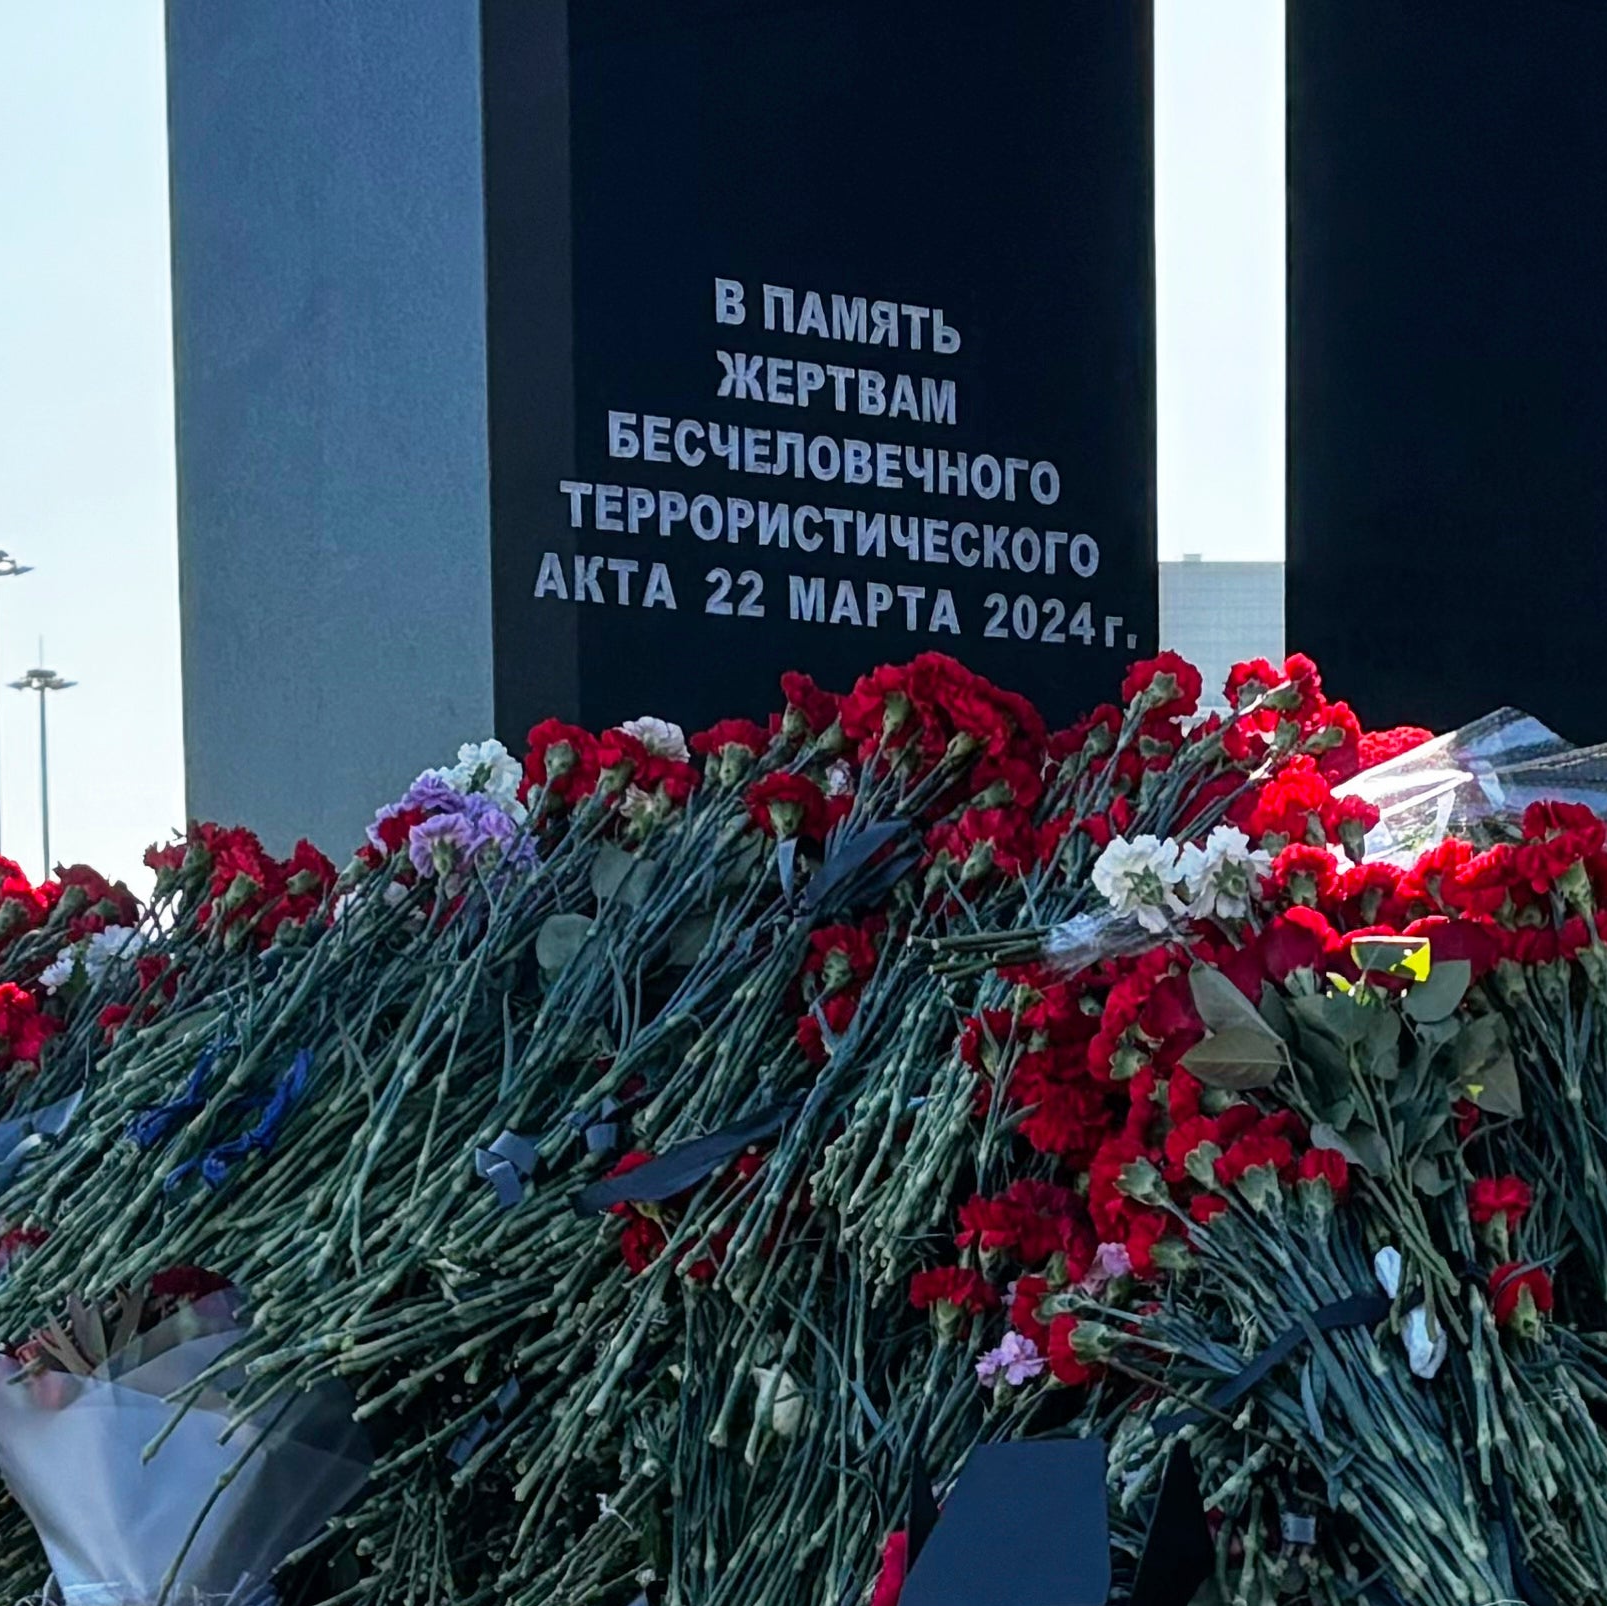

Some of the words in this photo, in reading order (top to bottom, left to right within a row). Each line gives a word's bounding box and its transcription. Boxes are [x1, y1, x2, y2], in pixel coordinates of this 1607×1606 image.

[715, 278, 745, 324] В
[763, 284, 960, 353] ПАМЯТЬ
[717, 351, 956, 424] ЖЕРТВАМ
[609, 410, 1059, 504] БЕСЧЕЛОВЕЧНОГО
[560, 481, 1099, 577] ТЕРРОРИСТИЧЕСКОГО
[535, 553, 676, 609] АКТА
[706, 568, 764, 616] 22
[789, 576, 960, 634] МАРТА
[984, 593, 1095, 644] 2024
